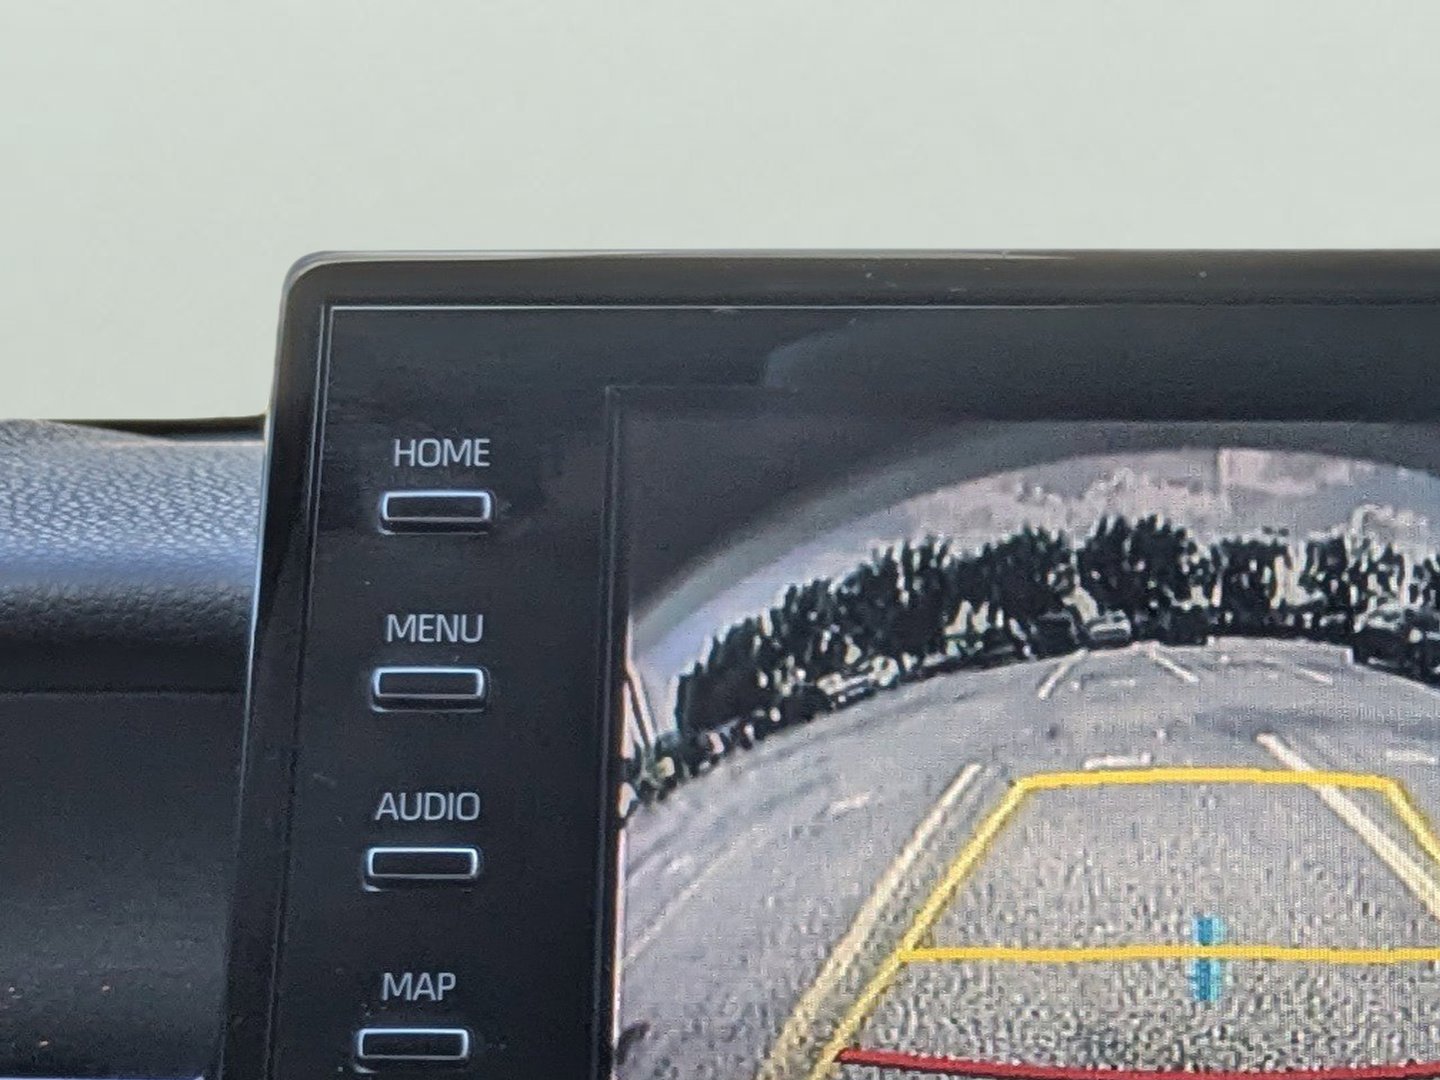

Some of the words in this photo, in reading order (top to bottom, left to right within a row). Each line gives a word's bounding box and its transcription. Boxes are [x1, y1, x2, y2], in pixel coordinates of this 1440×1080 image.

[393, 437, 491, 468] HOME
[386, 613, 484, 644] MENU
[374, 791, 481, 821] AUDIO
[381, 971, 457, 1002] MAP
